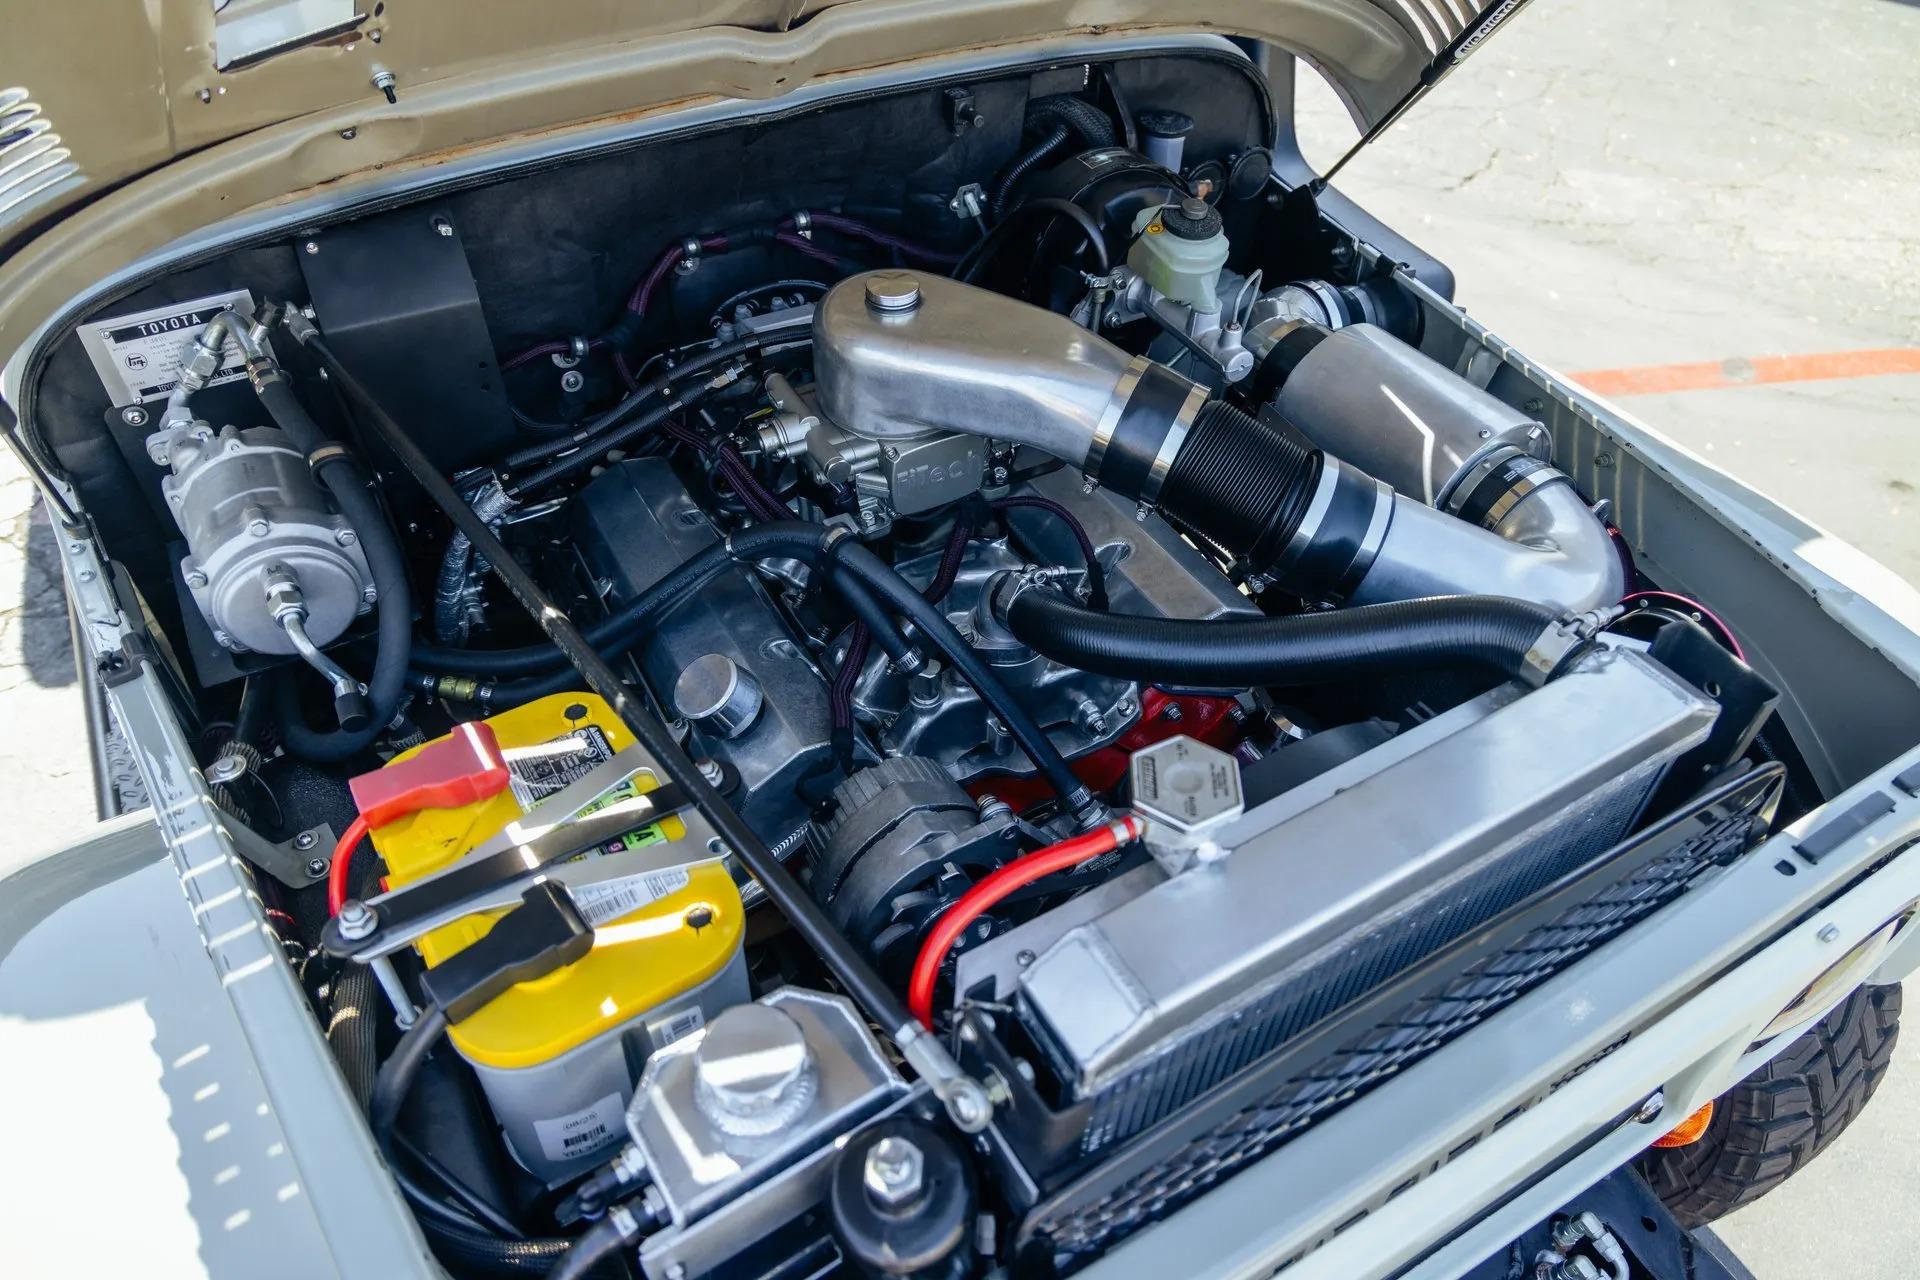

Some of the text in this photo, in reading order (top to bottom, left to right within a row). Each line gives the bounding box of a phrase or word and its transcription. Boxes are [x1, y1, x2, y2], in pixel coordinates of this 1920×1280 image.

[1480, 0, 1519, 35] CUSTO
[138, 313, 202, 337] TOYOTA
[157, 382, 177, 393] TOYO
